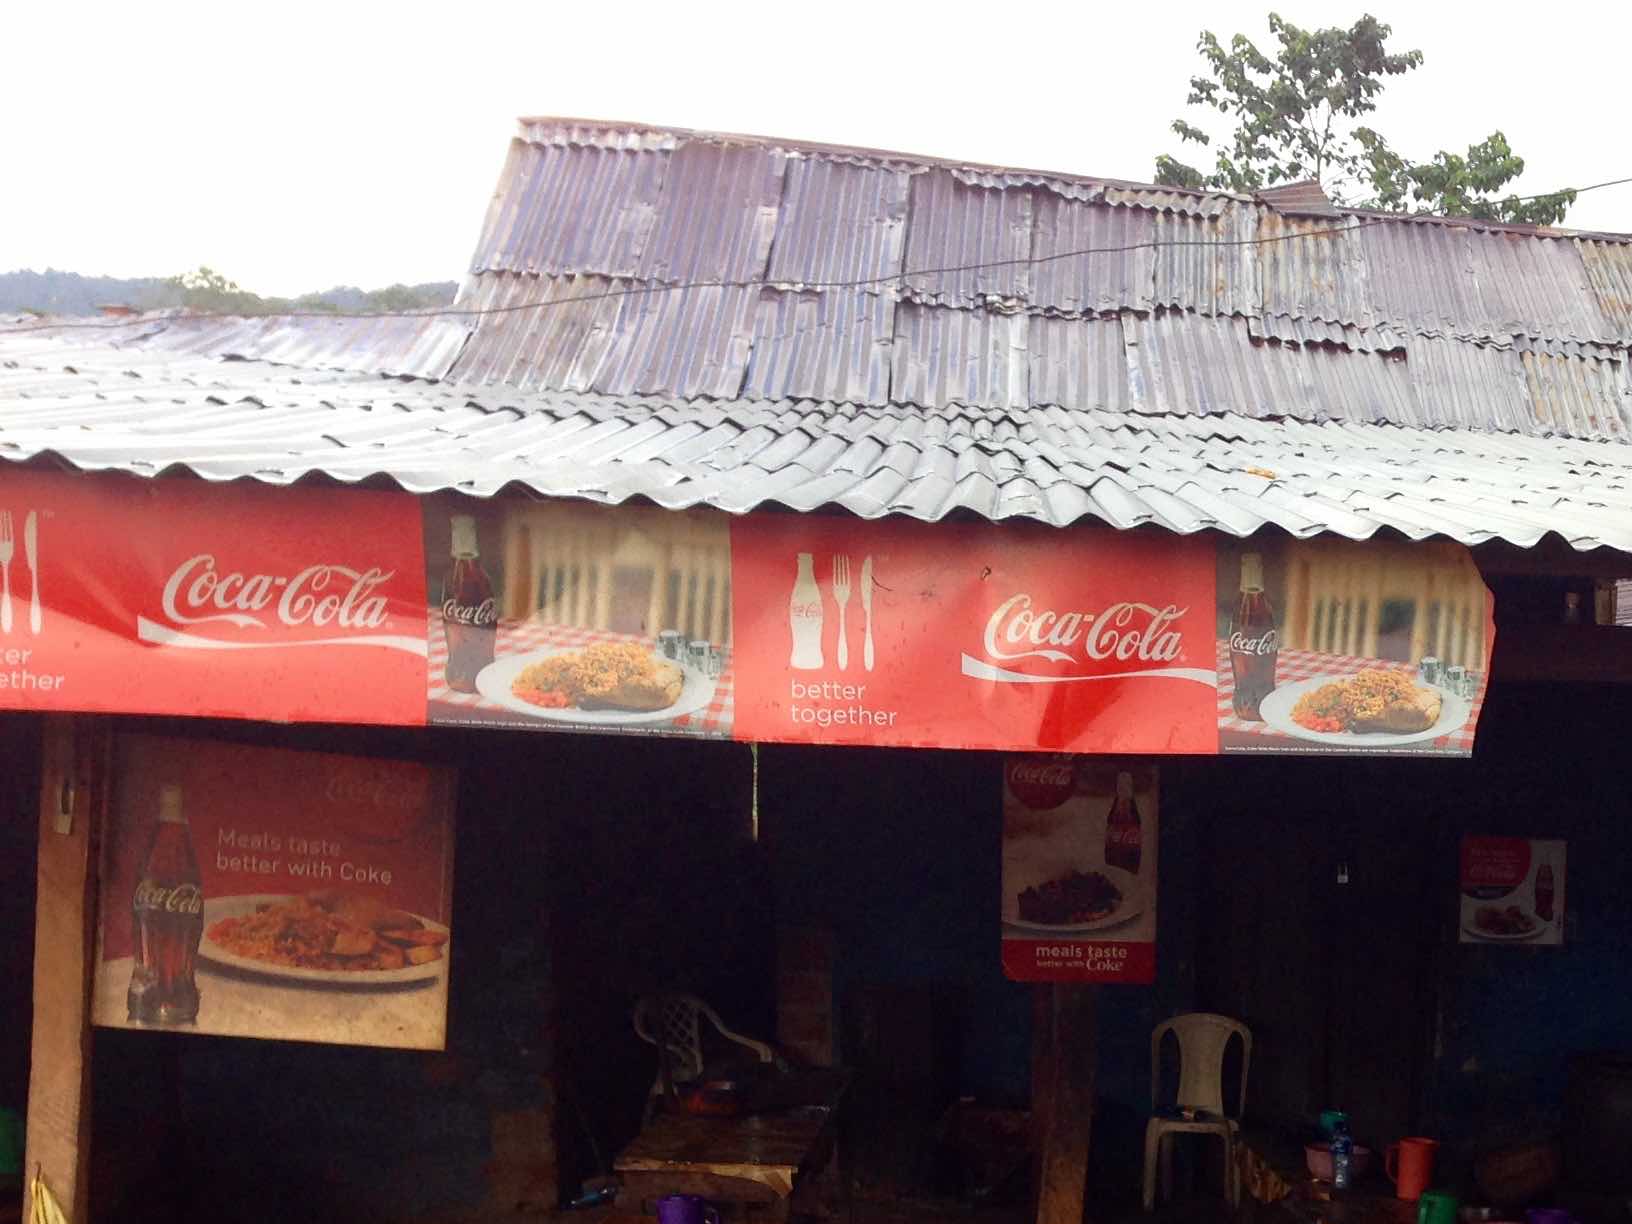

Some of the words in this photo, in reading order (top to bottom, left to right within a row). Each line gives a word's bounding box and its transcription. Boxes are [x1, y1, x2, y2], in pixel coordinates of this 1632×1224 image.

[162, 553, 398, 629] Coca-Cola
[983, 593, 1189, 664] Coca-Cola
[791, 679, 867, 701] better
[791, 703, 898, 727] together
[217, 828, 282, 851] Meals
[288, 836, 343, 857] taste
[216, 851, 281, 873] better
[288, 861, 333, 880] with
[340, 862, 393, 885] Coke
[1036, 945, 1083, 958] meals
[1087, 945, 1128, 959] taste
[1086, 959, 1124, 972] Coke
